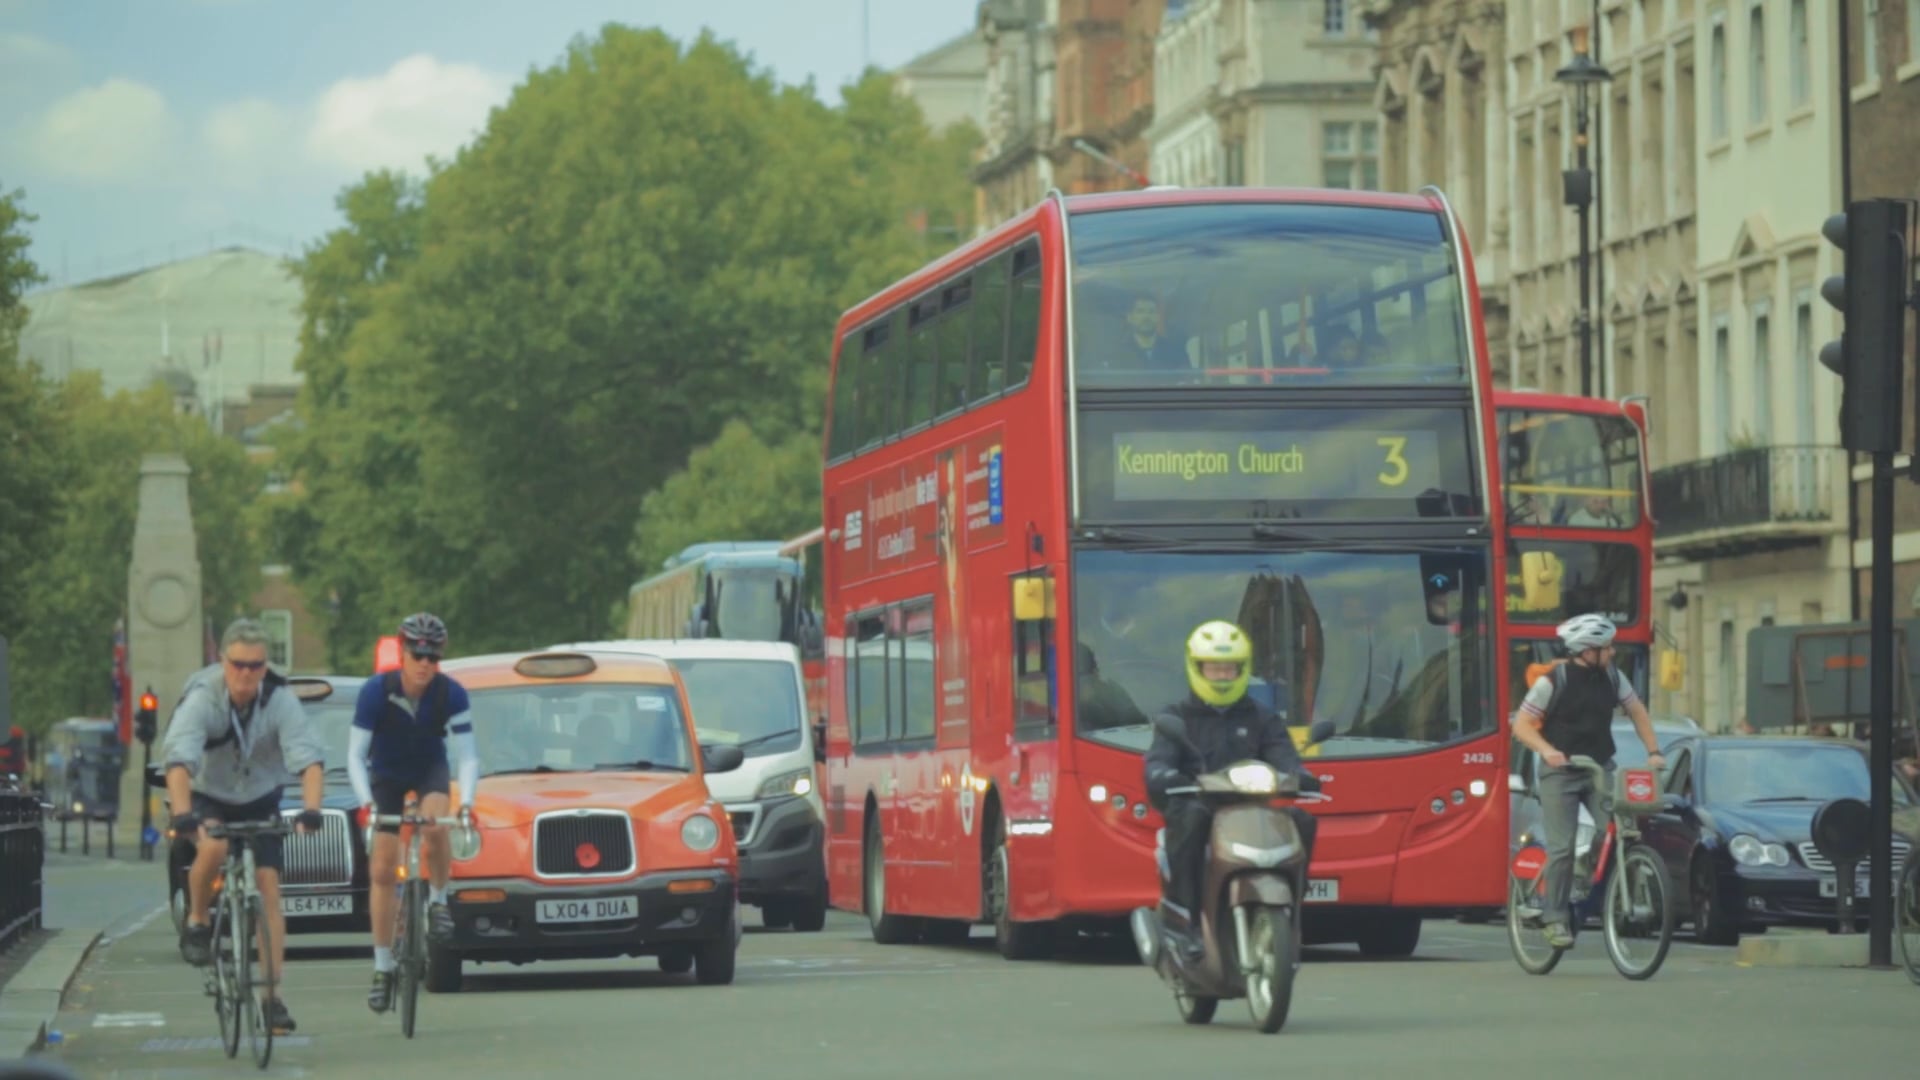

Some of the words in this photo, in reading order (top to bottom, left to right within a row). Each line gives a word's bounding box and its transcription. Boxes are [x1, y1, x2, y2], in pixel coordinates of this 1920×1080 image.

[1118, 444, 1228, 480] Kennington
[1238, 444, 1303, 473] Church
[1376, 437, 1409, 486] 3
[280, 898, 313, 913] L64
[317, 896, 346, 911] PKK
[543, 903, 590, 919] LX04
[596, 900, 631, 917] DUA
